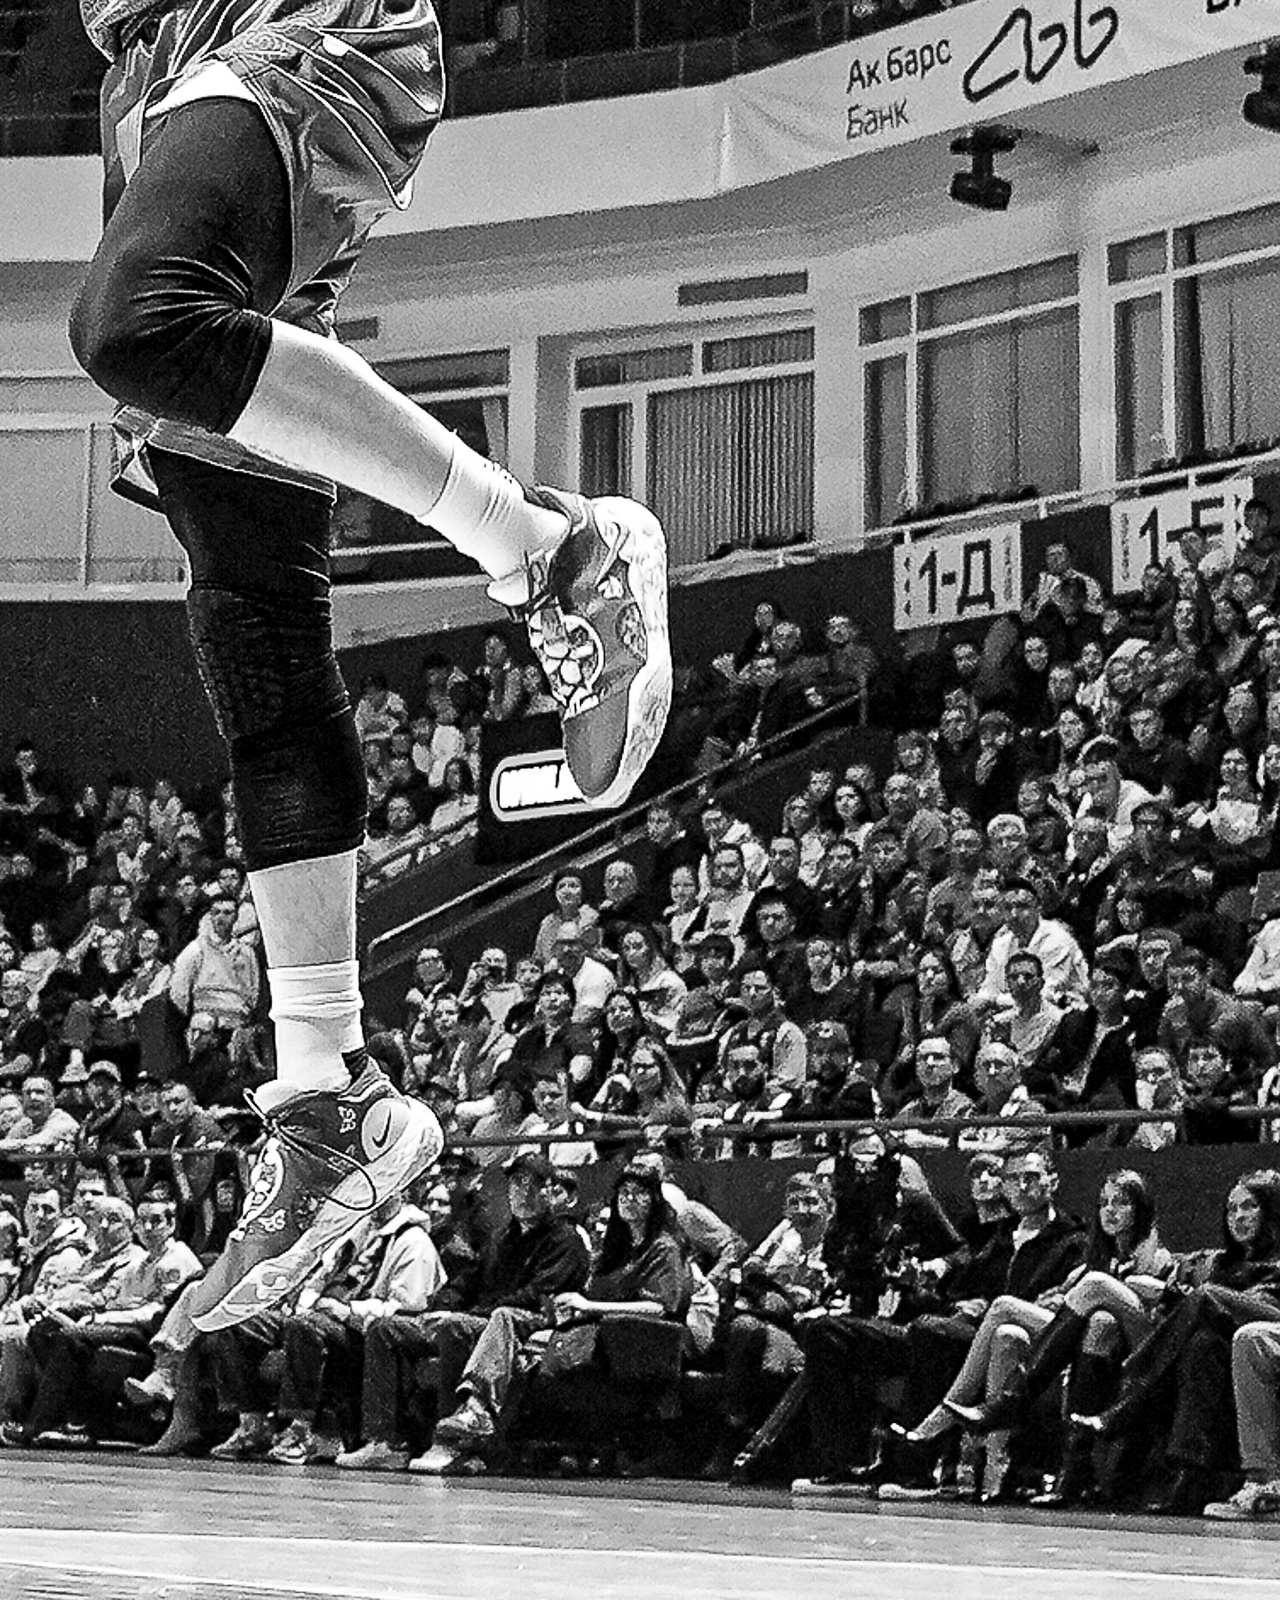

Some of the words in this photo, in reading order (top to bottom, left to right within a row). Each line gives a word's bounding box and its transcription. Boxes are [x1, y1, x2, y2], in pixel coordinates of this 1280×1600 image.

[846, 59, 881, 94] Ак
[846, 97, 909, 140] Банк
[919, 540, 996, 615] 1-Д
